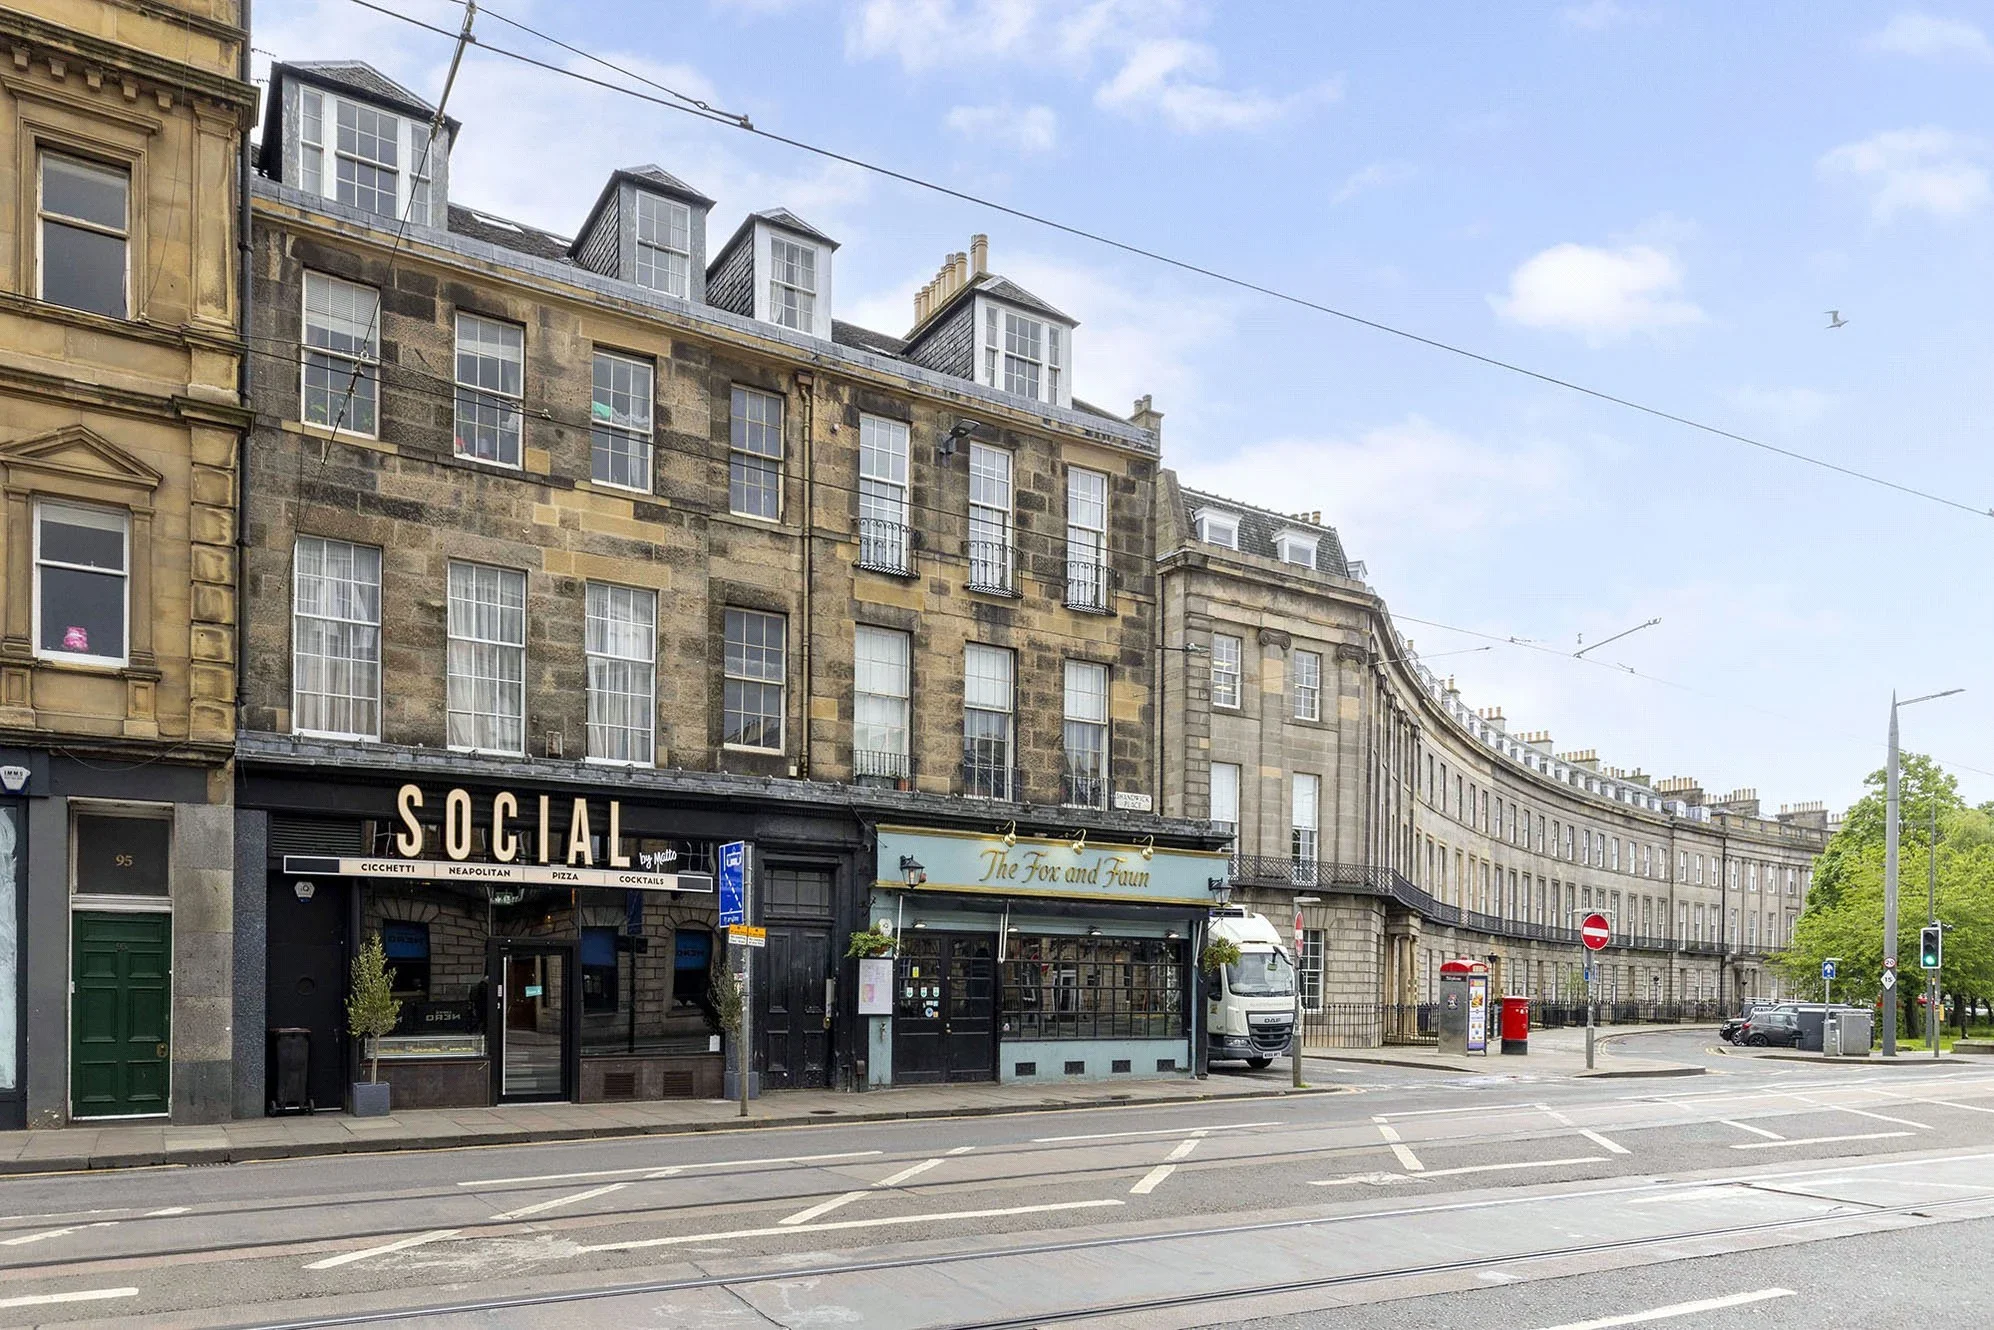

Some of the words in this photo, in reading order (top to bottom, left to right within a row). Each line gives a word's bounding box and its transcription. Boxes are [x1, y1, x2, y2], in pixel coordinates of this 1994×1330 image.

[1123, 800, 1143, 809] PLACE
[396, 783, 631, 867] SOCIAL
[115, 854, 133, 867] 95
[639, 852, 652, 869] by
[653, 848, 678, 865] Matto
[979, 847, 1019, 882] The
[1021, 851, 1061, 884] Fox
[1064, 857, 1102, 885] and
[1102, 856, 1150, 889] Faun
[361, 863, 416, 873] CICCHETTI
[449, 867, 511, 877] NEAPOLITAN
[552, 871, 579, 881] PIZZA
[619, 875, 665, 886] COCKTAILS
